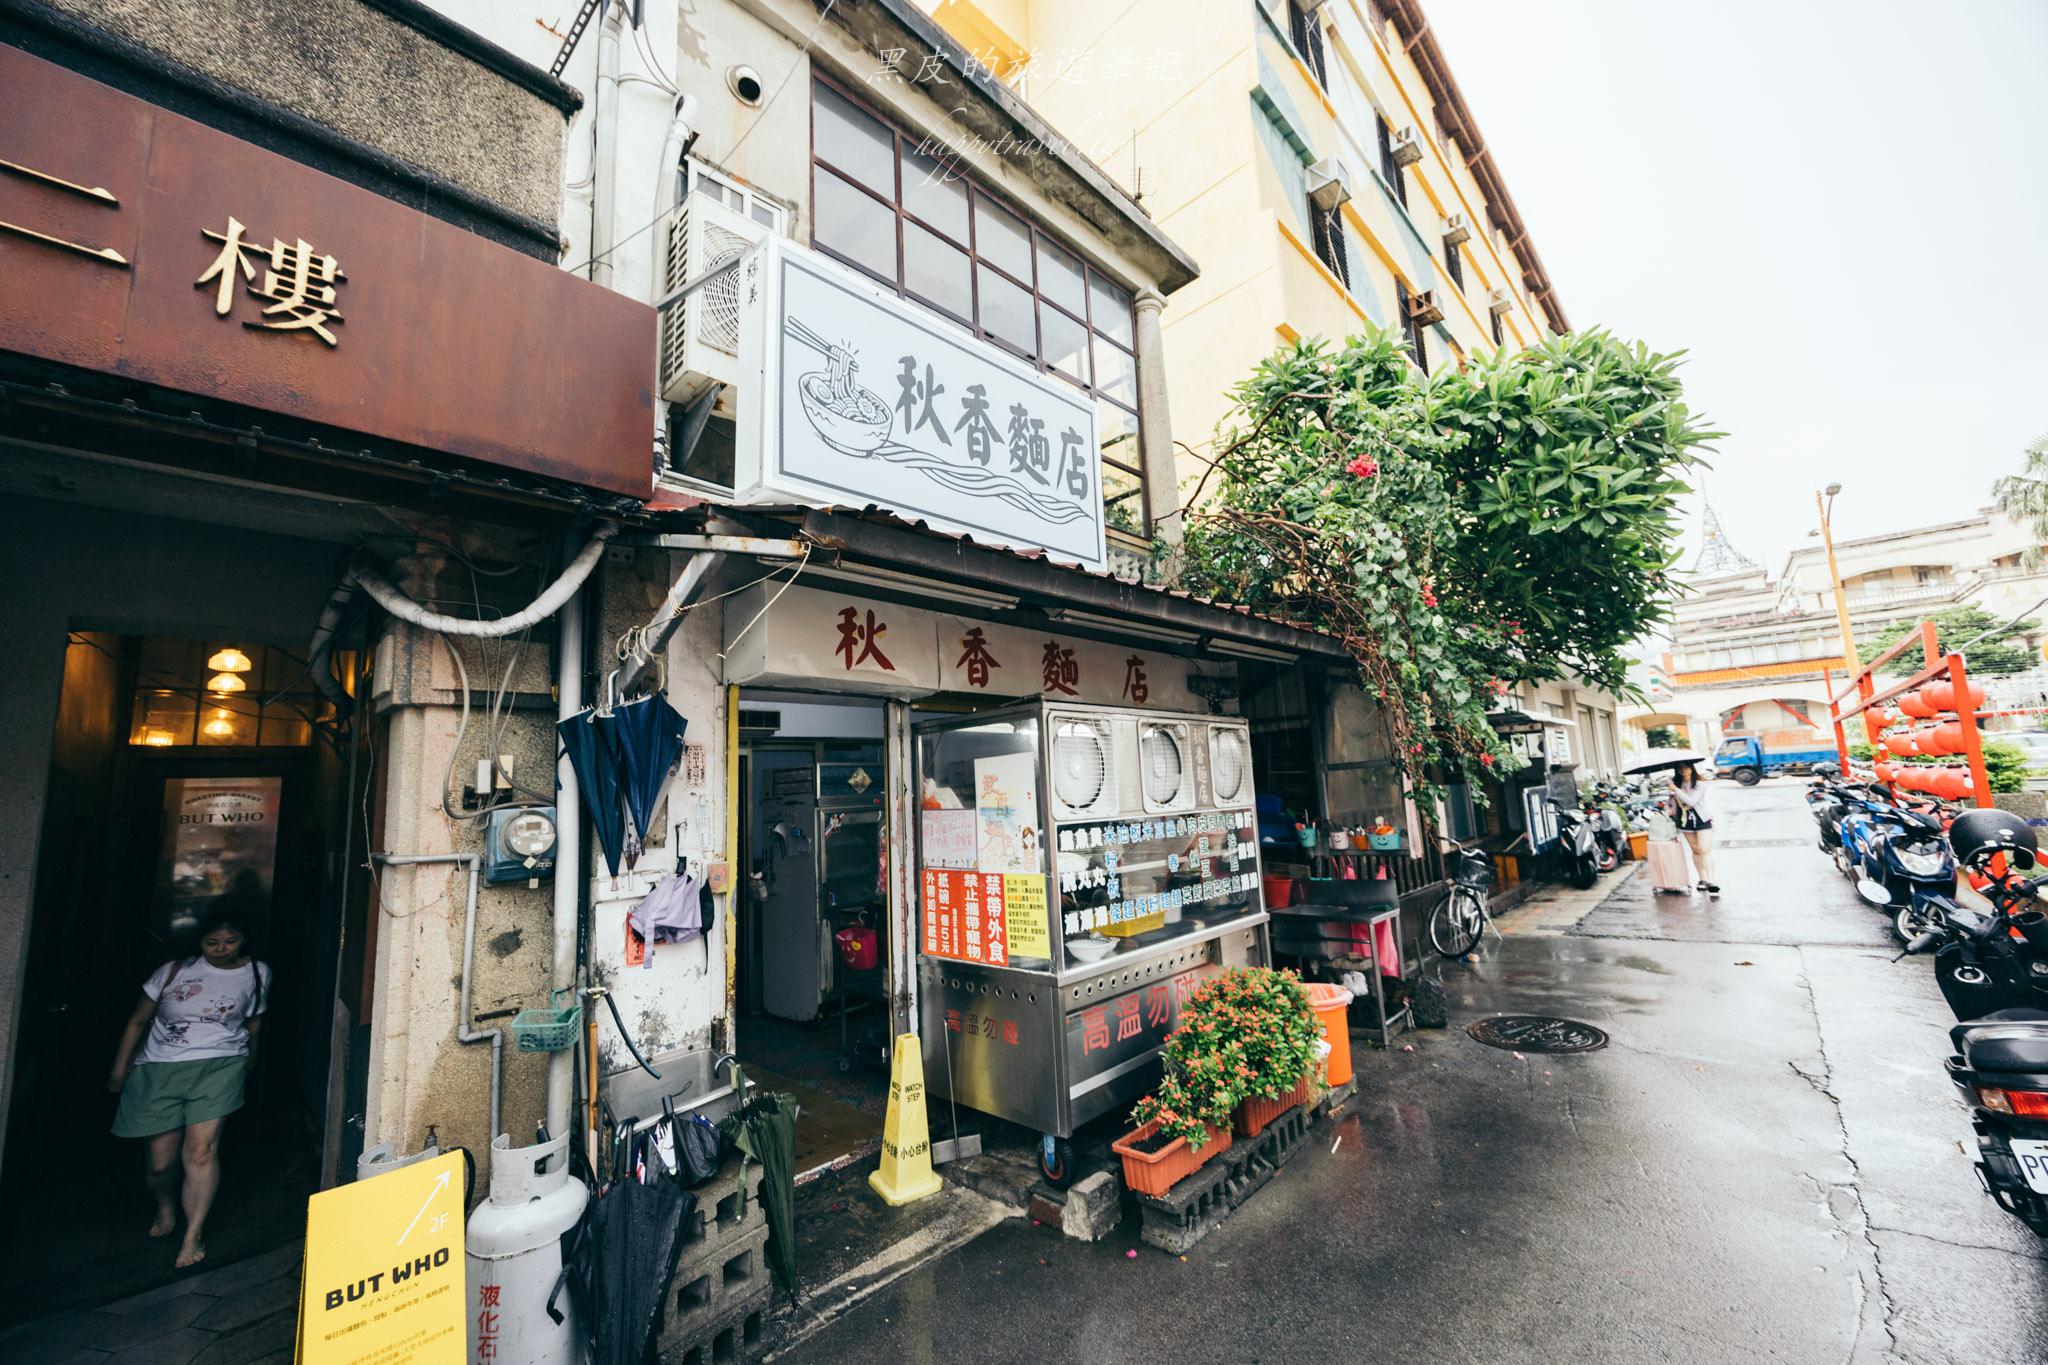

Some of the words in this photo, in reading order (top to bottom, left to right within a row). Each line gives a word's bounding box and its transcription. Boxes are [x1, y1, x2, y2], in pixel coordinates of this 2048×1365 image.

[895, 355, 1090, 500] 秋香麵店
[835, 605, 1149, 705] 秋香麵店
[180, 813, 217, 825] BUT
[220, 811, 264, 823] WHO
[938, 873, 950, 953] 紙碗一個5元
[986, 875, 1005, 963] 禁帶外食
[905, 1082, 923, 1094] WATCH
[907, 1092, 921, 1103] STEP
[901, 1140, 929, 1160] 小心台階
[429, 1213, 449, 1234] 2F
[325, 1272, 385, 1312] BUT
[392, 1247, 450, 1287] WHO
[477, 1284, 502, 1365] 液化石
